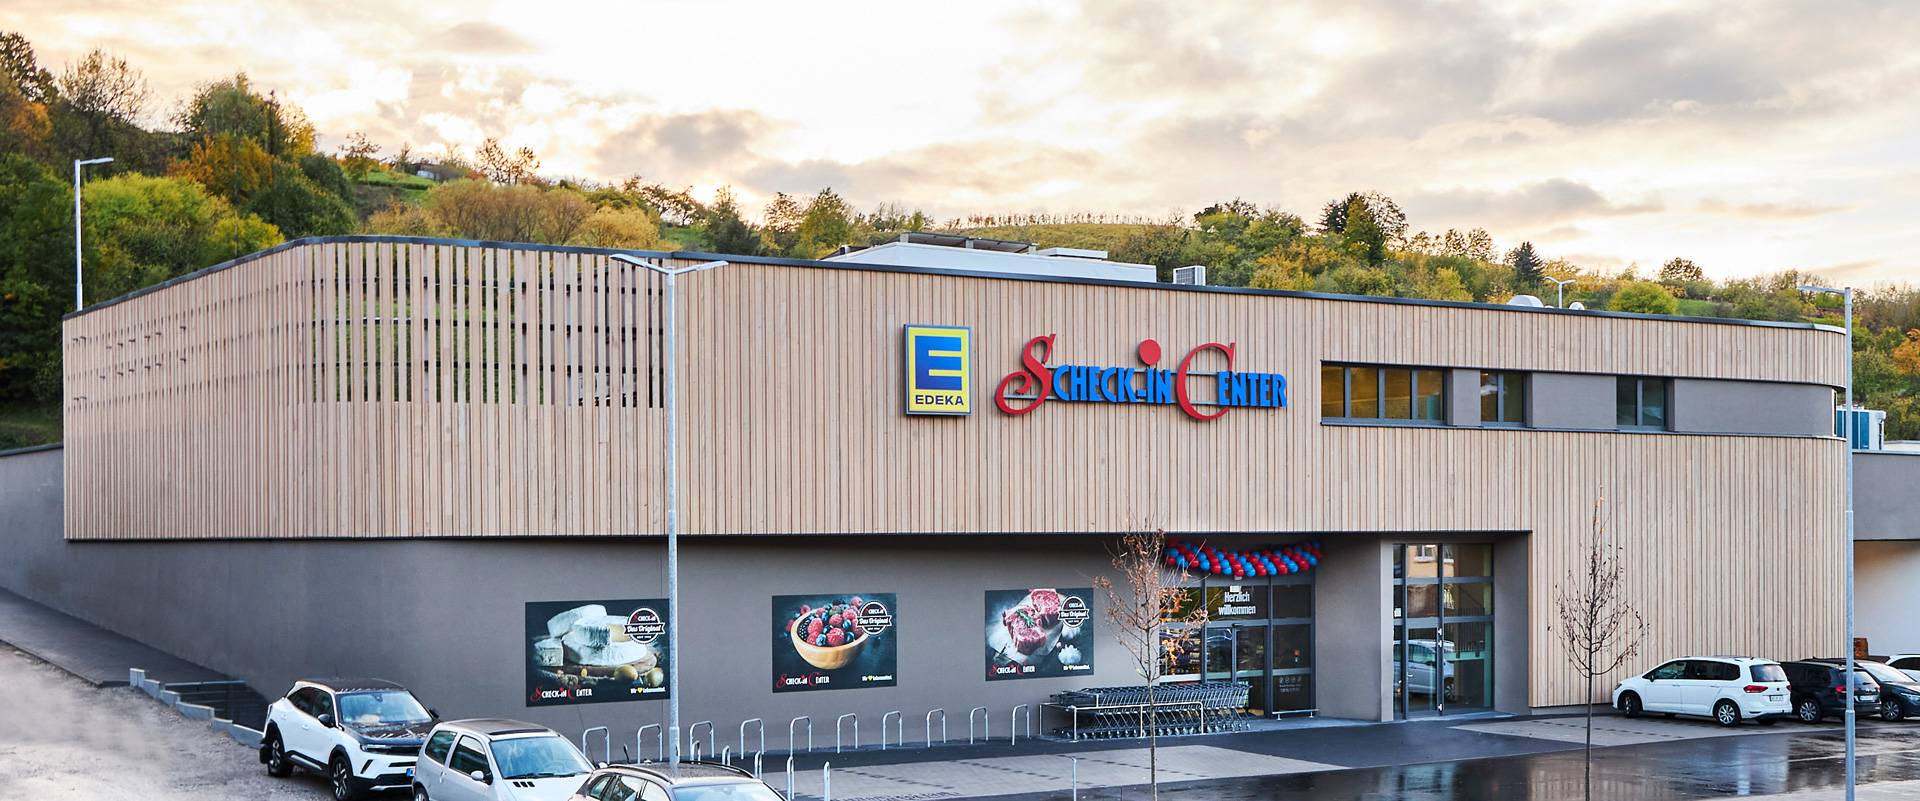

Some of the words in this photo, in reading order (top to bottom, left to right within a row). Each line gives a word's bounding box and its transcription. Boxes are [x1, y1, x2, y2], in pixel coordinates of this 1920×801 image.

[915, 336, 963, 390] E
[1176, 342, 1288, 421] CENTER
[915, 394, 965, 406] EDEKA
[1224, 591, 1250, 602] Herzlich
[1218, 604, 1256, 615] willkommen
[869, 618, 889, 626] Original
[640, 625, 662, 634] Original
